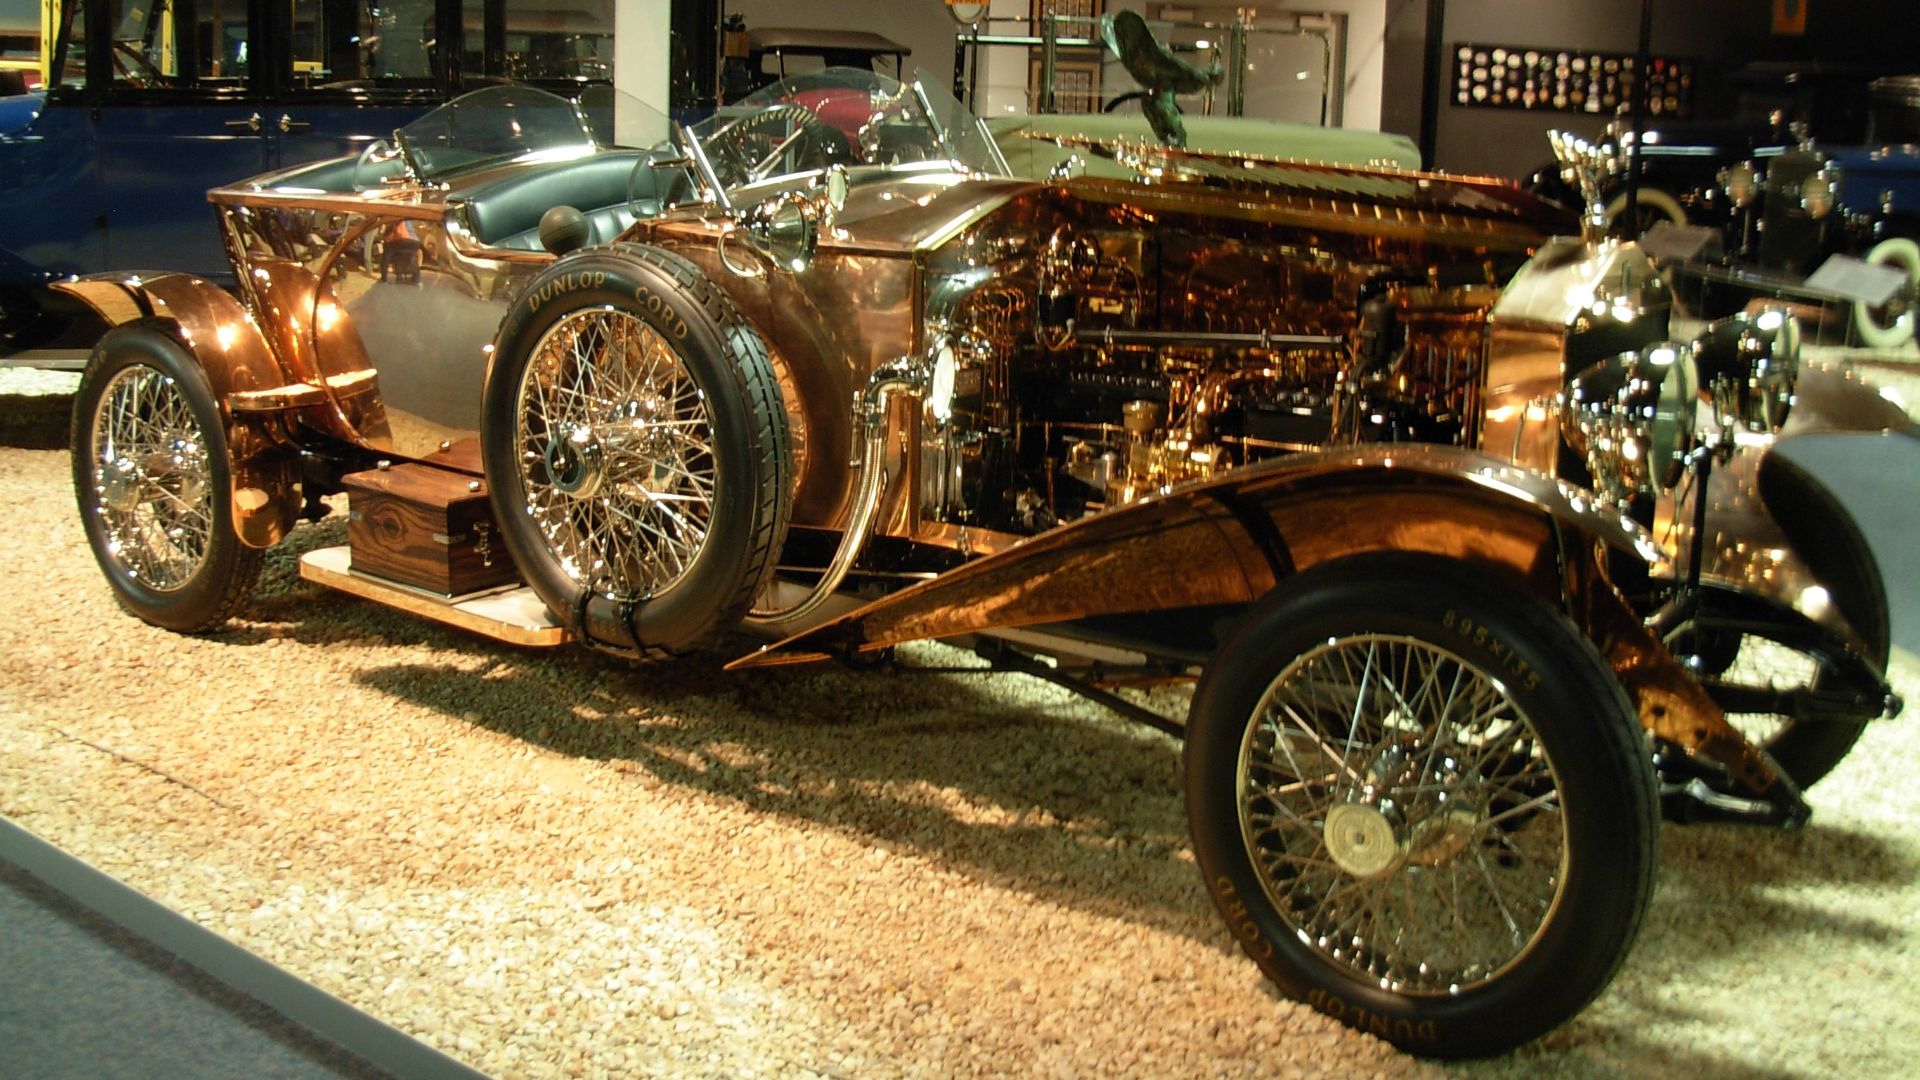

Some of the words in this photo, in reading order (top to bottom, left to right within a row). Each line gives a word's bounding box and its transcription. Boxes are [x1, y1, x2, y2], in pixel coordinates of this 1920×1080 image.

[529, 271, 605, 312] DUNLOP
[635, 286, 688, 339] CORD
[1217, 876, 1272, 959] CORD
